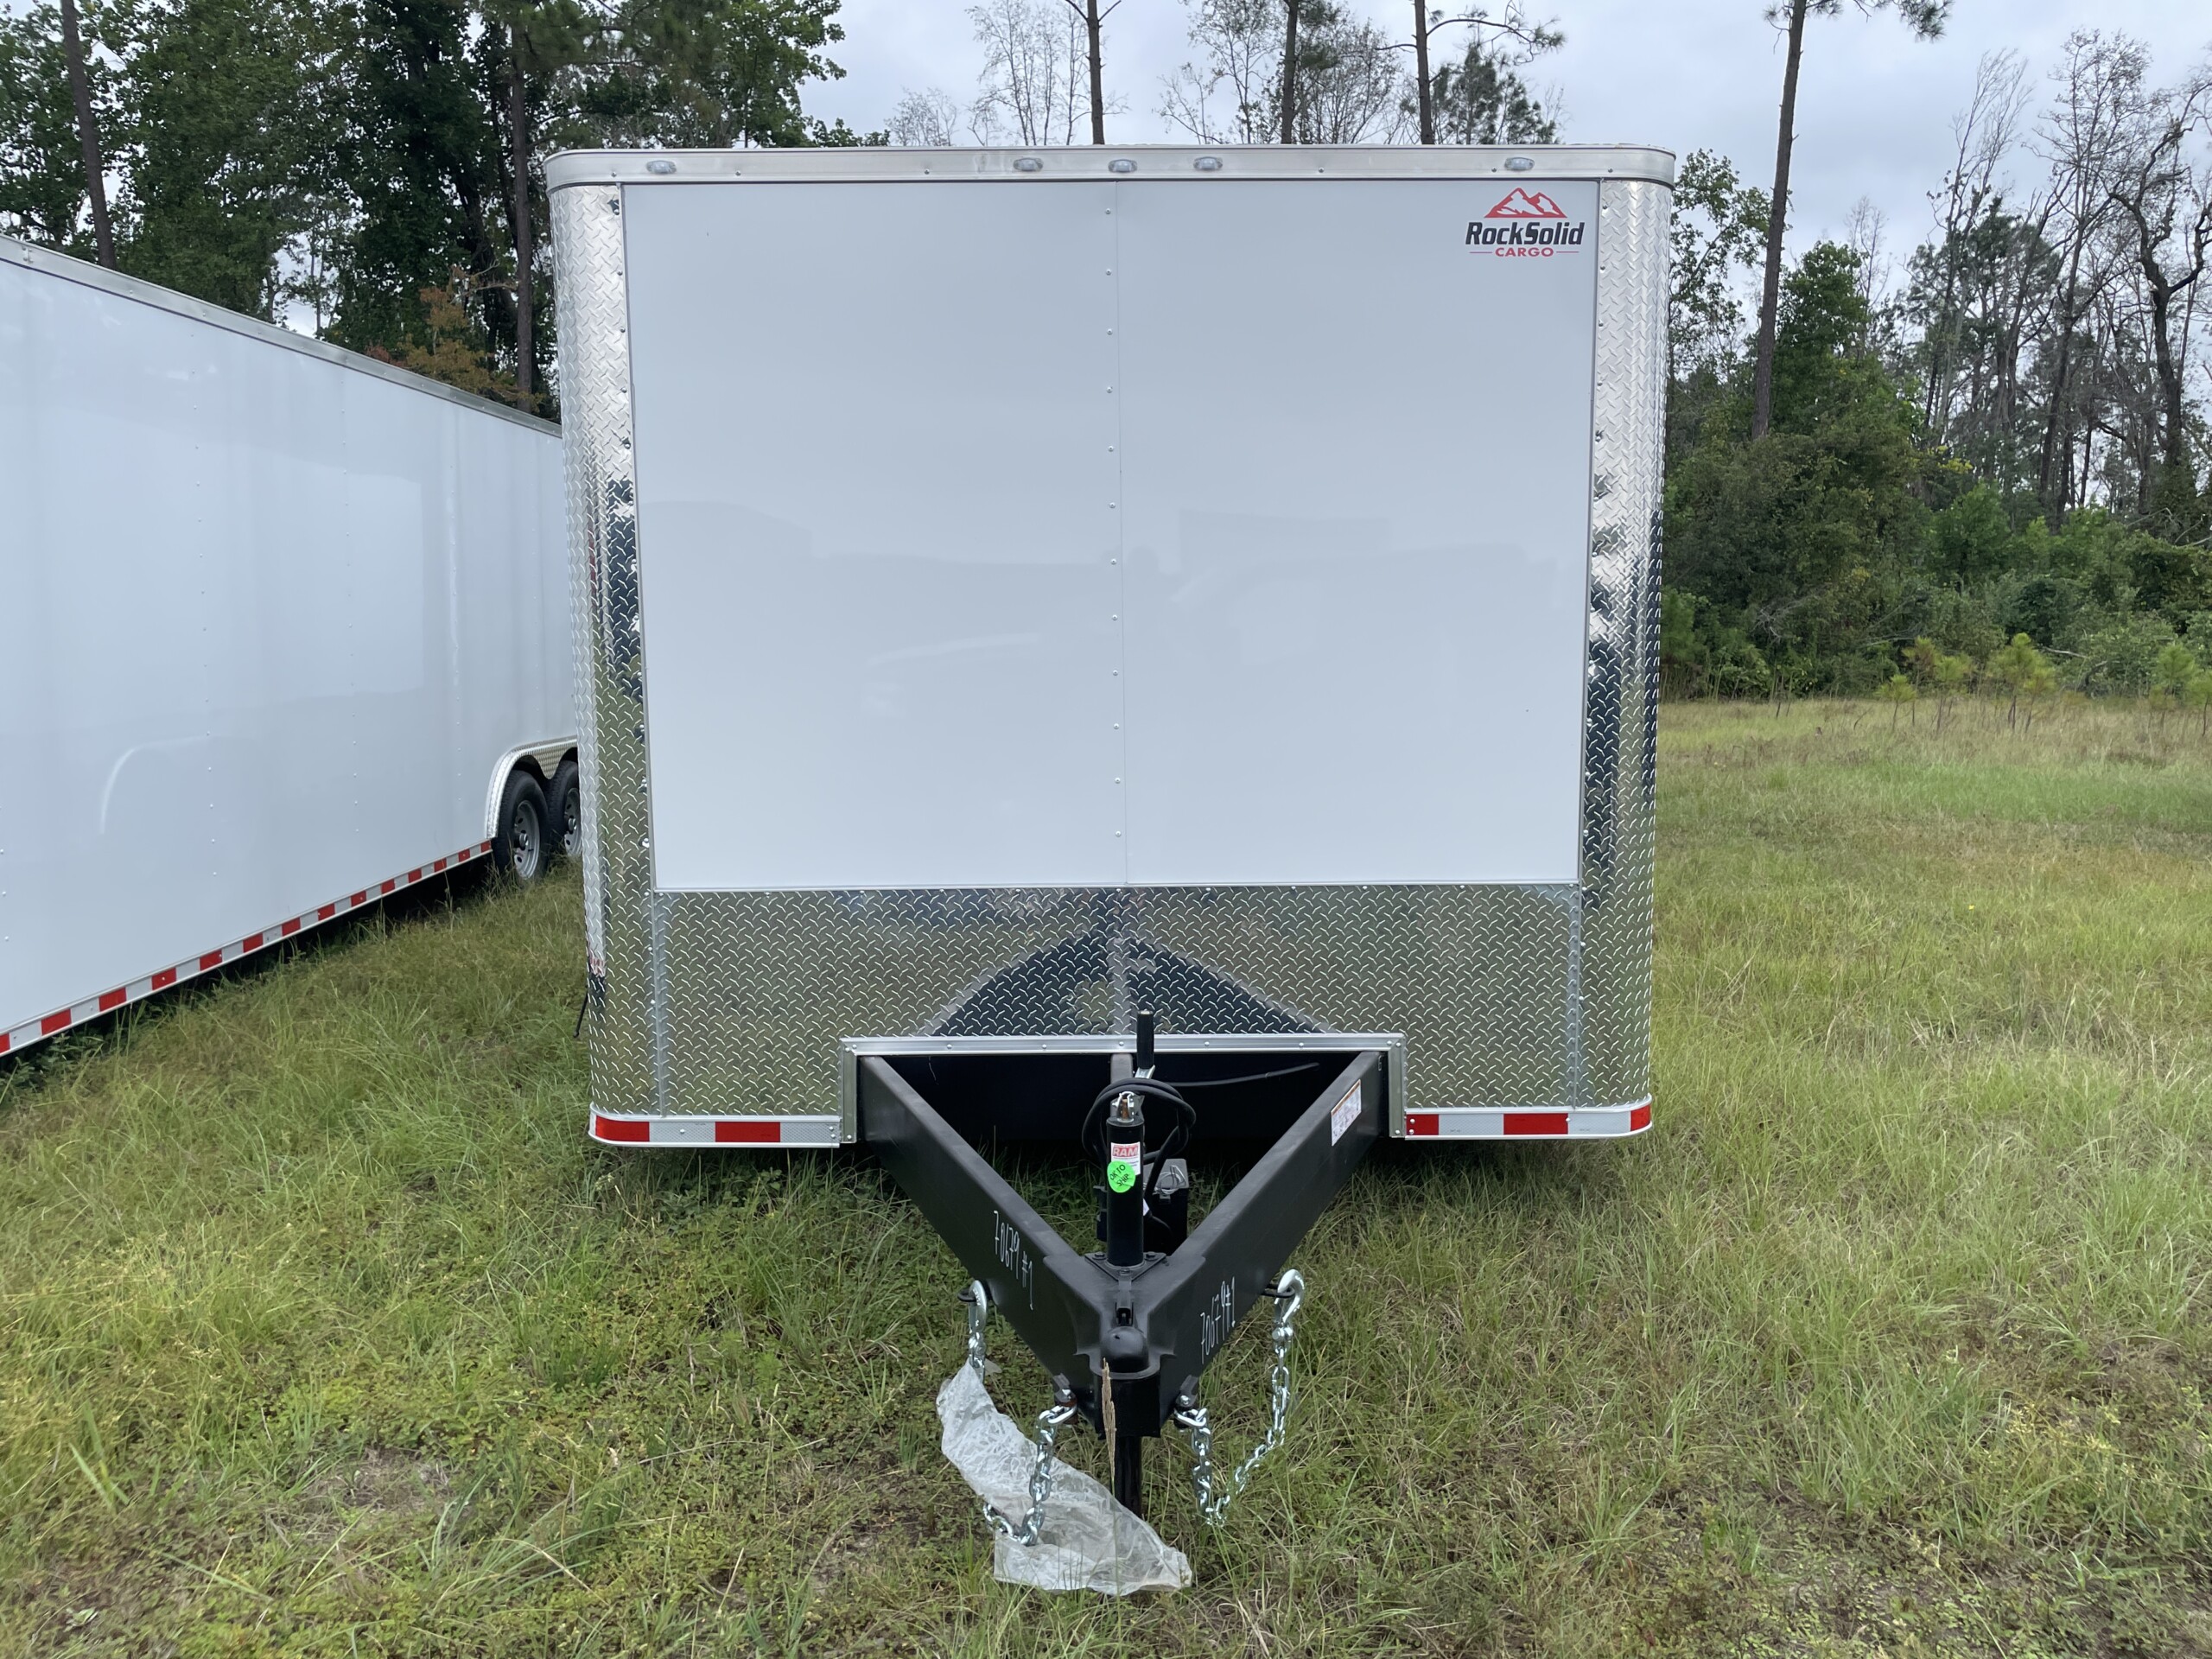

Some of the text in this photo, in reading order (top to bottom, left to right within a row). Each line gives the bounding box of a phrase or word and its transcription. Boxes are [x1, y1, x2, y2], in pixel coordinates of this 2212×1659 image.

[1465, 221, 1585, 245] RockSolid
[1495, 247, 1554, 257] CARGO
[1112, 1147, 1139, 1157] RAM
[1116, 1164, 1126, 1174] TO
